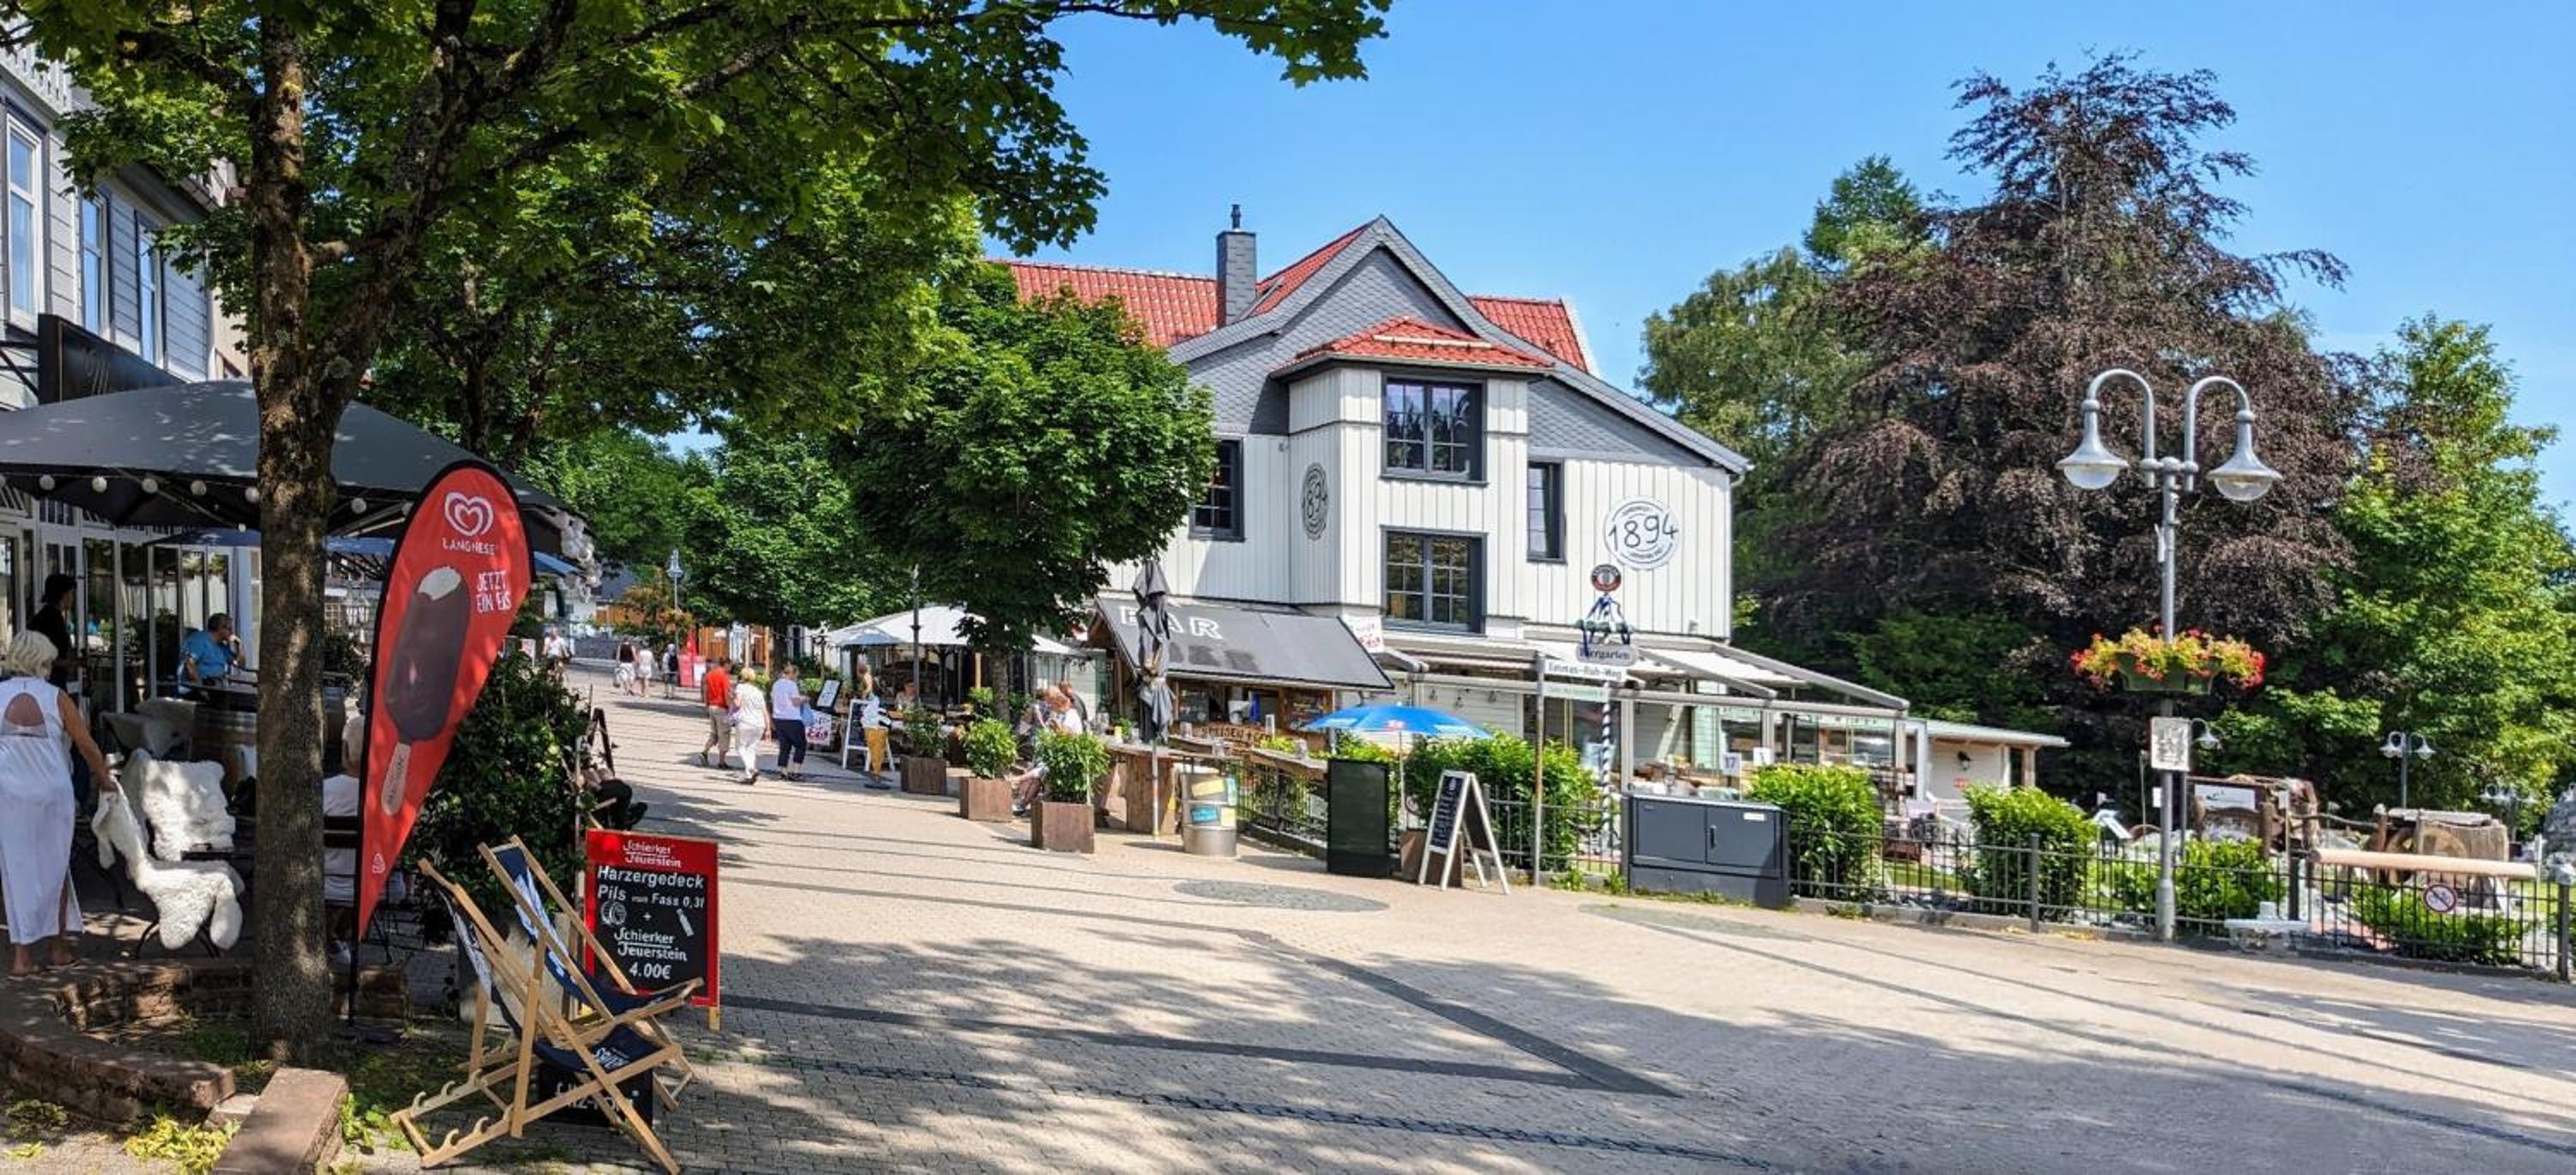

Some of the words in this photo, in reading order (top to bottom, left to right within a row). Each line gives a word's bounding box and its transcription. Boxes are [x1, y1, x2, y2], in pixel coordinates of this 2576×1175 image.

[1301, 478, 1328, 519] 1894
[1608, 514, 1679, 551] 1894
[442, 538, 495, 556] LANGNESE
[477, 570, 507, 592] JETZT
[477, 594, 494, 613] EIN
[495, 591, 512, 611] EIS
[598, 866, 704, 889] Harzergedeck
[598, 885, 626, 901] Pils
[652, 892, 680, 906] Fass
[614, 927, 676, 944] Schierker
[629, 962, 671, 979] 4.00€
